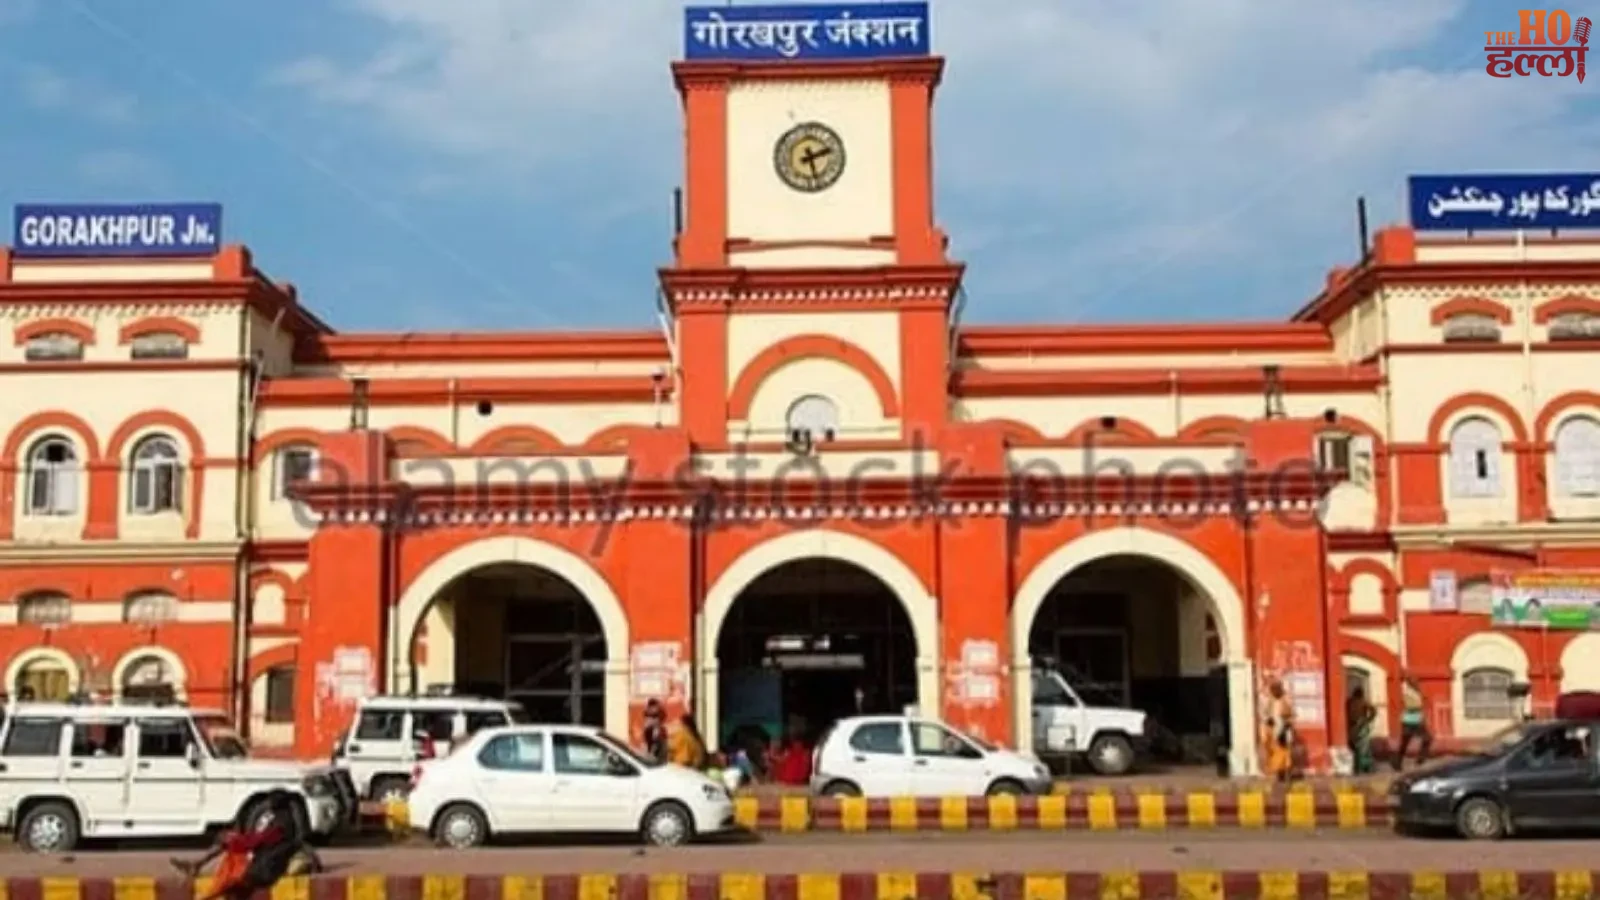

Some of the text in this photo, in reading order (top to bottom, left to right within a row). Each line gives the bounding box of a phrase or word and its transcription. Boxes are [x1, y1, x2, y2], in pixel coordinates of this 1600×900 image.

[691, 10, 922, 57] गोरखपुर जंक्शन
[21, 214, 175, 246] GORAKHPUR
